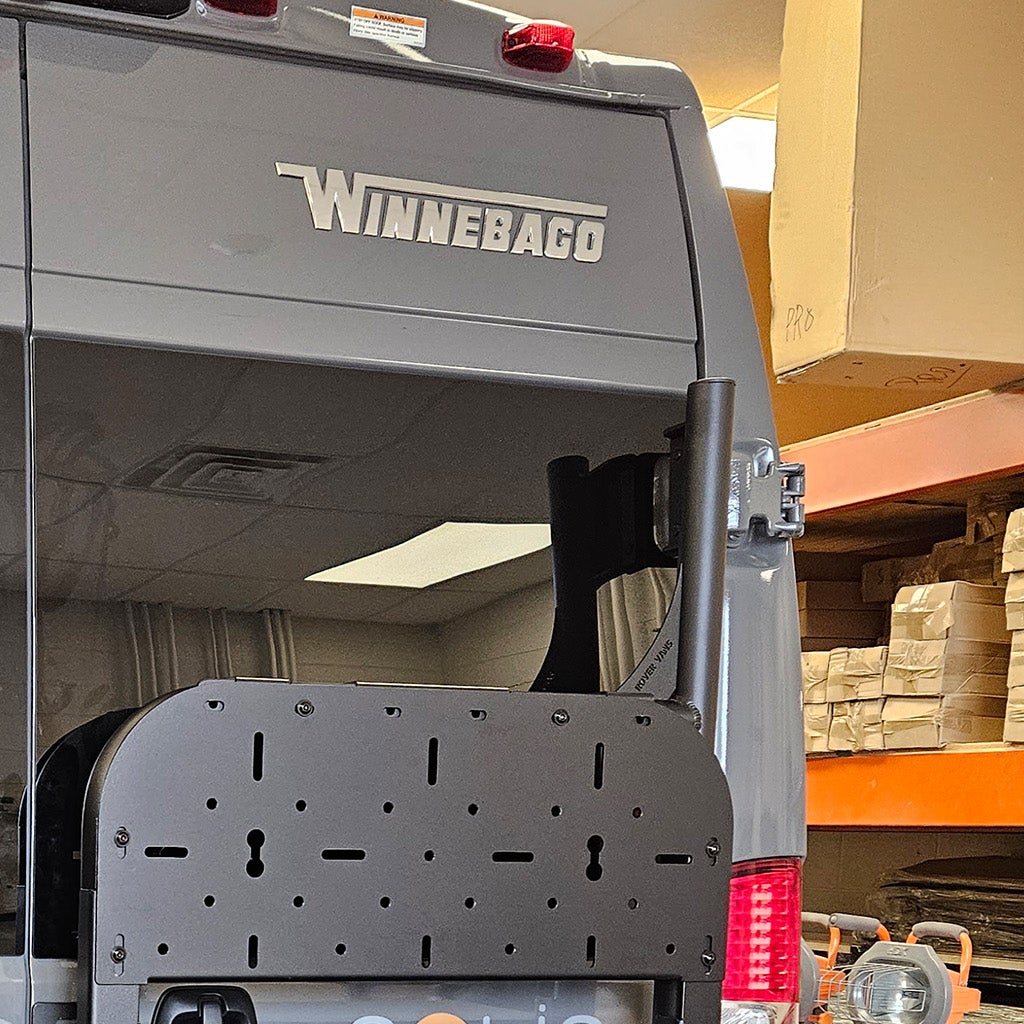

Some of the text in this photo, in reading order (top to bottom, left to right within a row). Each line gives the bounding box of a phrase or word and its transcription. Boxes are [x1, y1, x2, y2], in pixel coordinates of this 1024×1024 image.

[275, 162, 608, 263] WINNEBAGO
[634, 639, 674, 692] ROVER VANS
